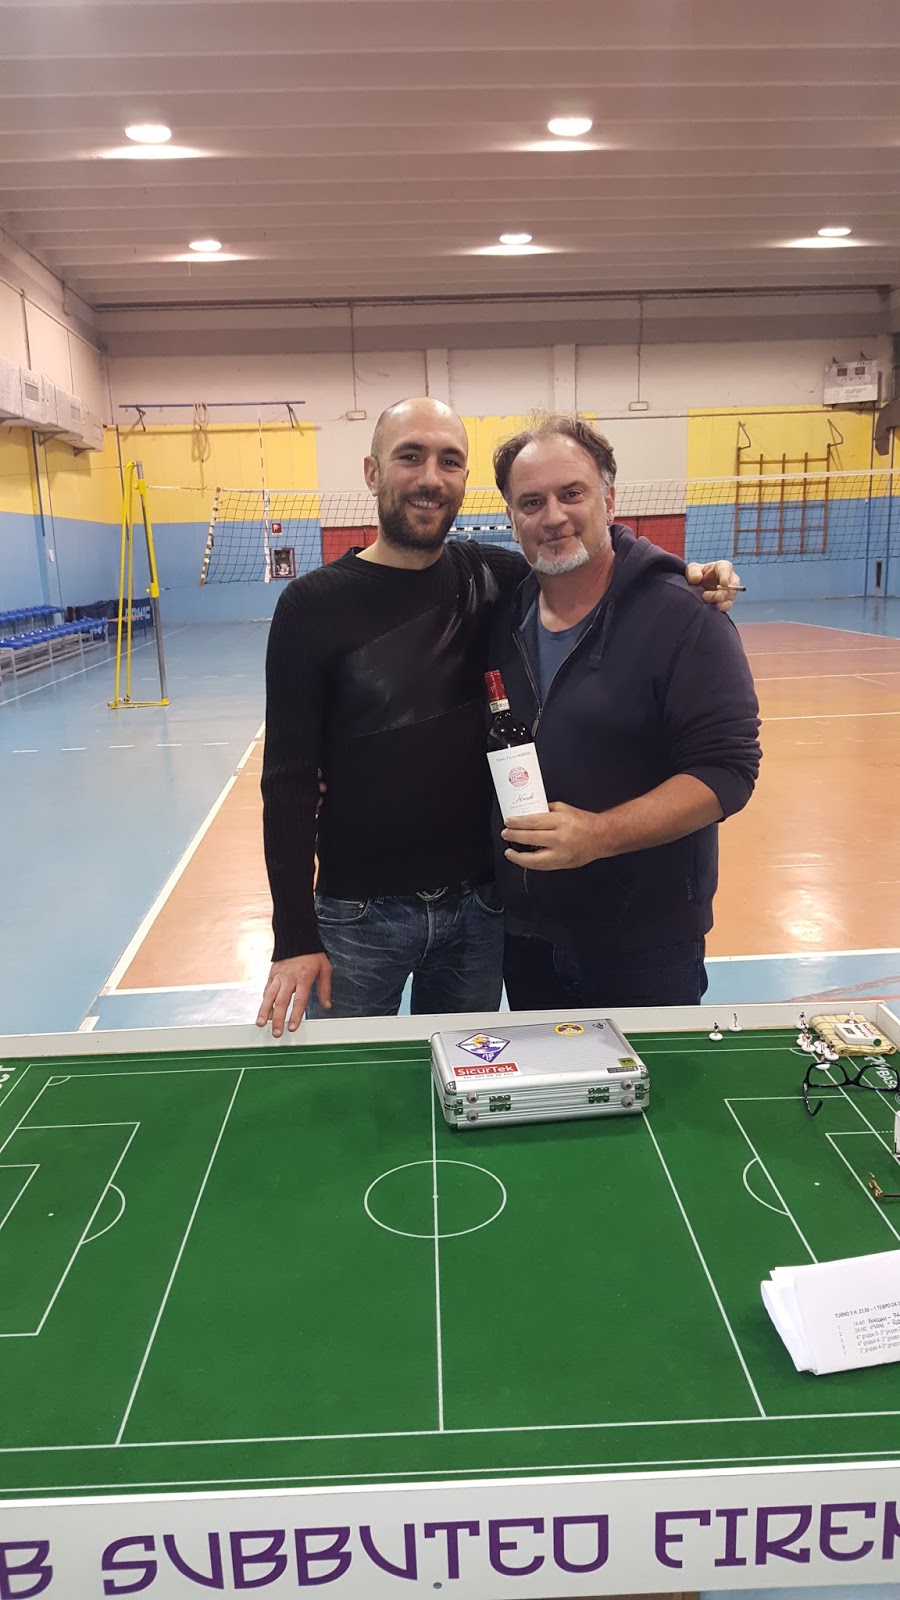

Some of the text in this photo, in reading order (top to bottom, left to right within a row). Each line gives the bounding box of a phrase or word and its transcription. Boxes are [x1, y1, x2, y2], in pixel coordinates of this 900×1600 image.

[457, 1065, 514, 1076] SicurTek
[877, 1302, 891, 1310] TEMPO
[101, 1514, 609, 1596] SUBBUTEO
